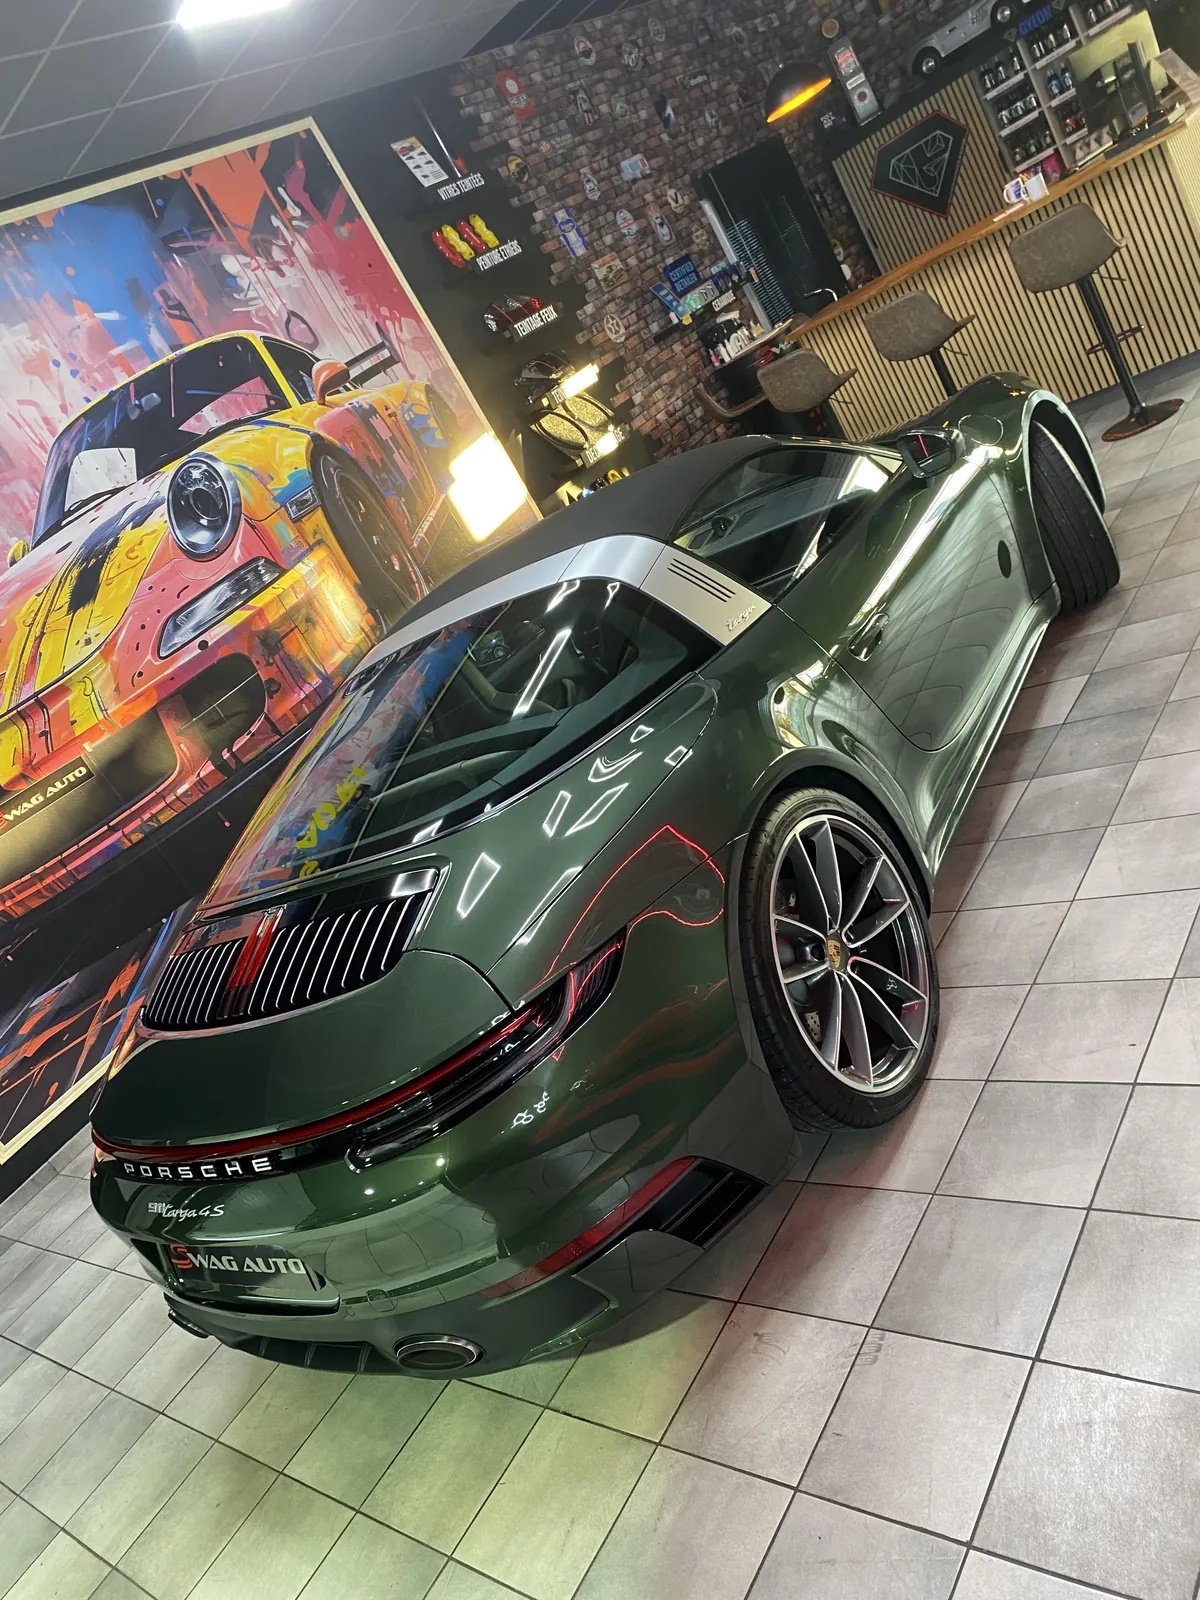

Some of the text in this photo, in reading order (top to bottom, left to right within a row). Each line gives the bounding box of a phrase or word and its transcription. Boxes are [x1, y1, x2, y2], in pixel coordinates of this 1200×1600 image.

[437, 182, 460, 200] VITRES
[456, 172, 484, 193] TEINTÉES
[476, 249, 504, 270] PEINTURE
[668, 261, 694, 282] CERTIFIED
[674, 272, 698, 292] DETAILER
[514, 304, 558, 337] TEINTAGE FEUX
[46, 766, 87, 798] AUTO
[124, 1157, 272, 1178] PORSCHE
[170, 1244, 306, 1274] SWAG AUTO
